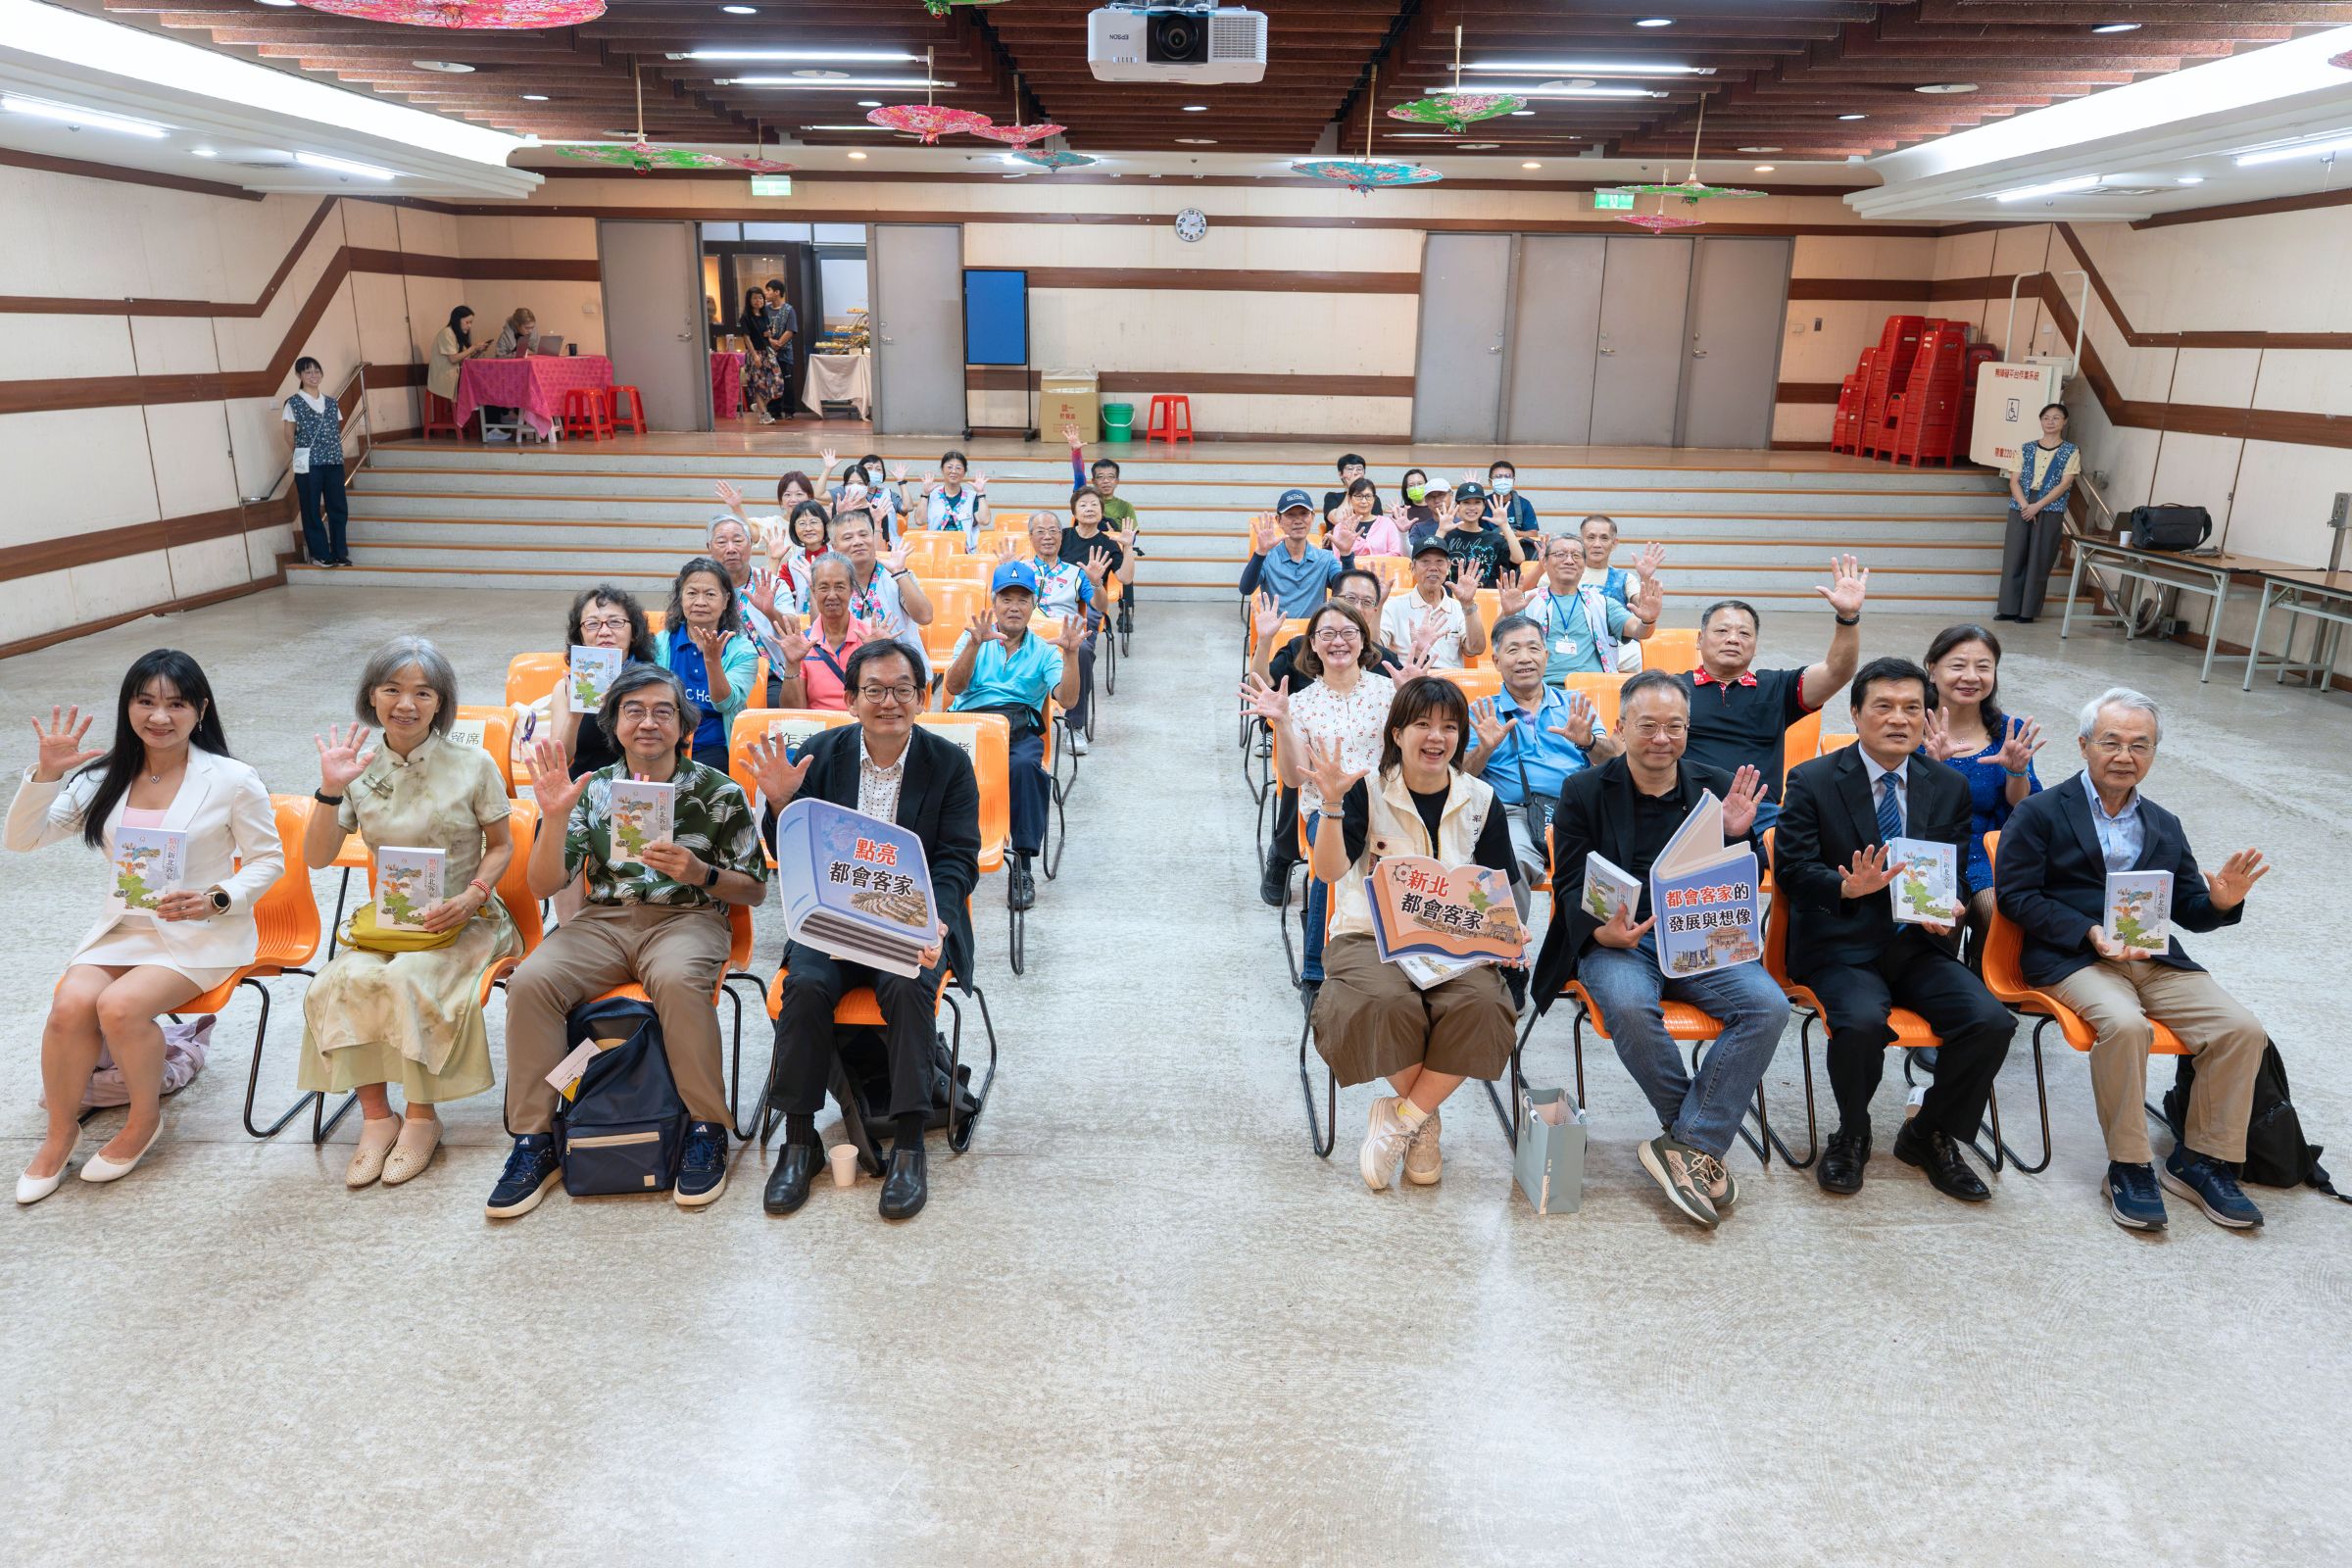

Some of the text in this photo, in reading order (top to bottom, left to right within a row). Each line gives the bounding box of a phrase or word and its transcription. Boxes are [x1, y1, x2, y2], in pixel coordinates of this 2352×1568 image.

[854, 838, 898, 866] 點亮
[829, 860, 913, 897] 都會客家
[1406, 869, 1449, 897] 新北
[1666, 882, 1749, 907] 都會客家的
[1400, 892, 1484, 930] 都會客家
[1668, 908, 1752, 932] 發展與想像
